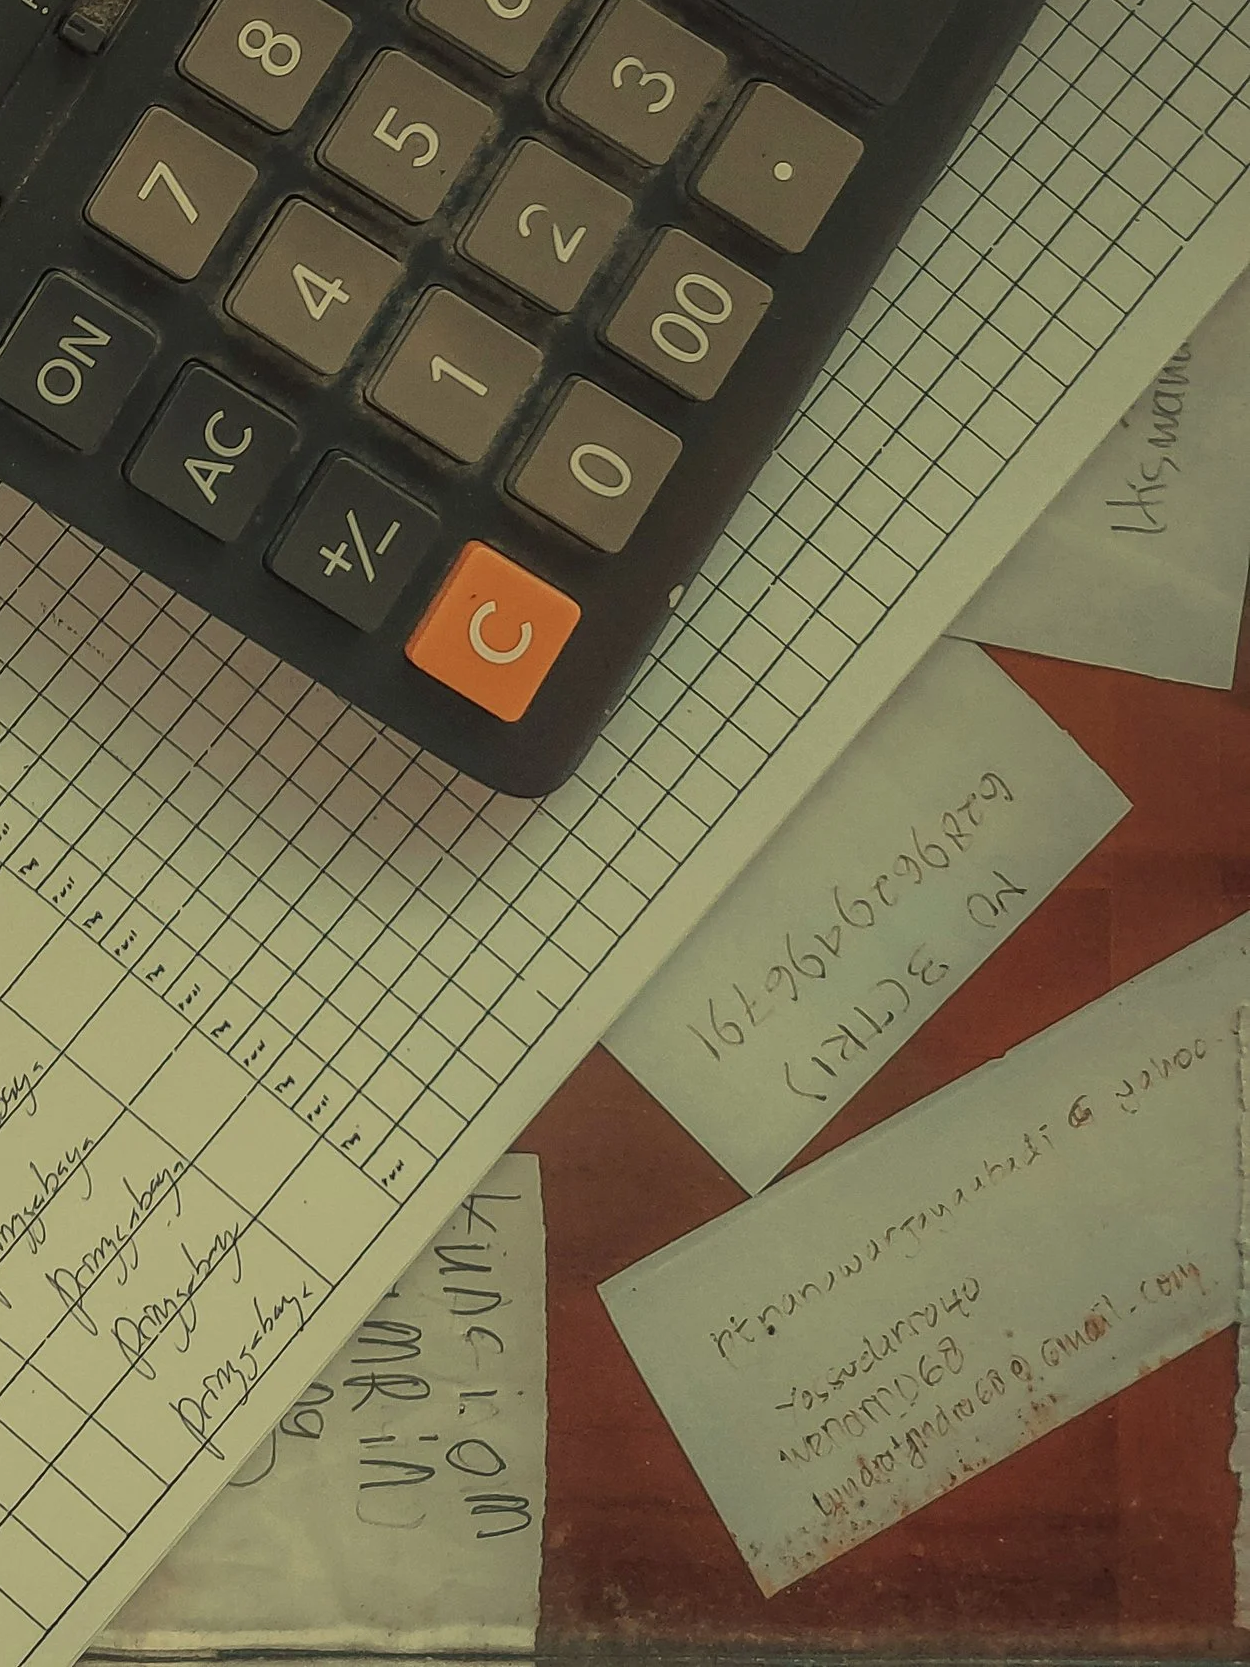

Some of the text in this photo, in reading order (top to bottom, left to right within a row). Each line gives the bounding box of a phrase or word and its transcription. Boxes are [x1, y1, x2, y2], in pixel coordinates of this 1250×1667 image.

[236, 19, 302, 75] 8
[611, 56, 676, 114] 3
[372, 106, 440, 168] 5
[135, 161, 200, 225] 7
[519, 203, 587, 264] 2
[291, 262, 351, 320] 4
[651, 272, 734, 363] 00
[36, 314, 112, 405] ON
[429, 354, 489, 397] 1
[183, 409, 256, 504] AC
[570, 443, 632, 497] 0
[468, 599, 533, 665] C
